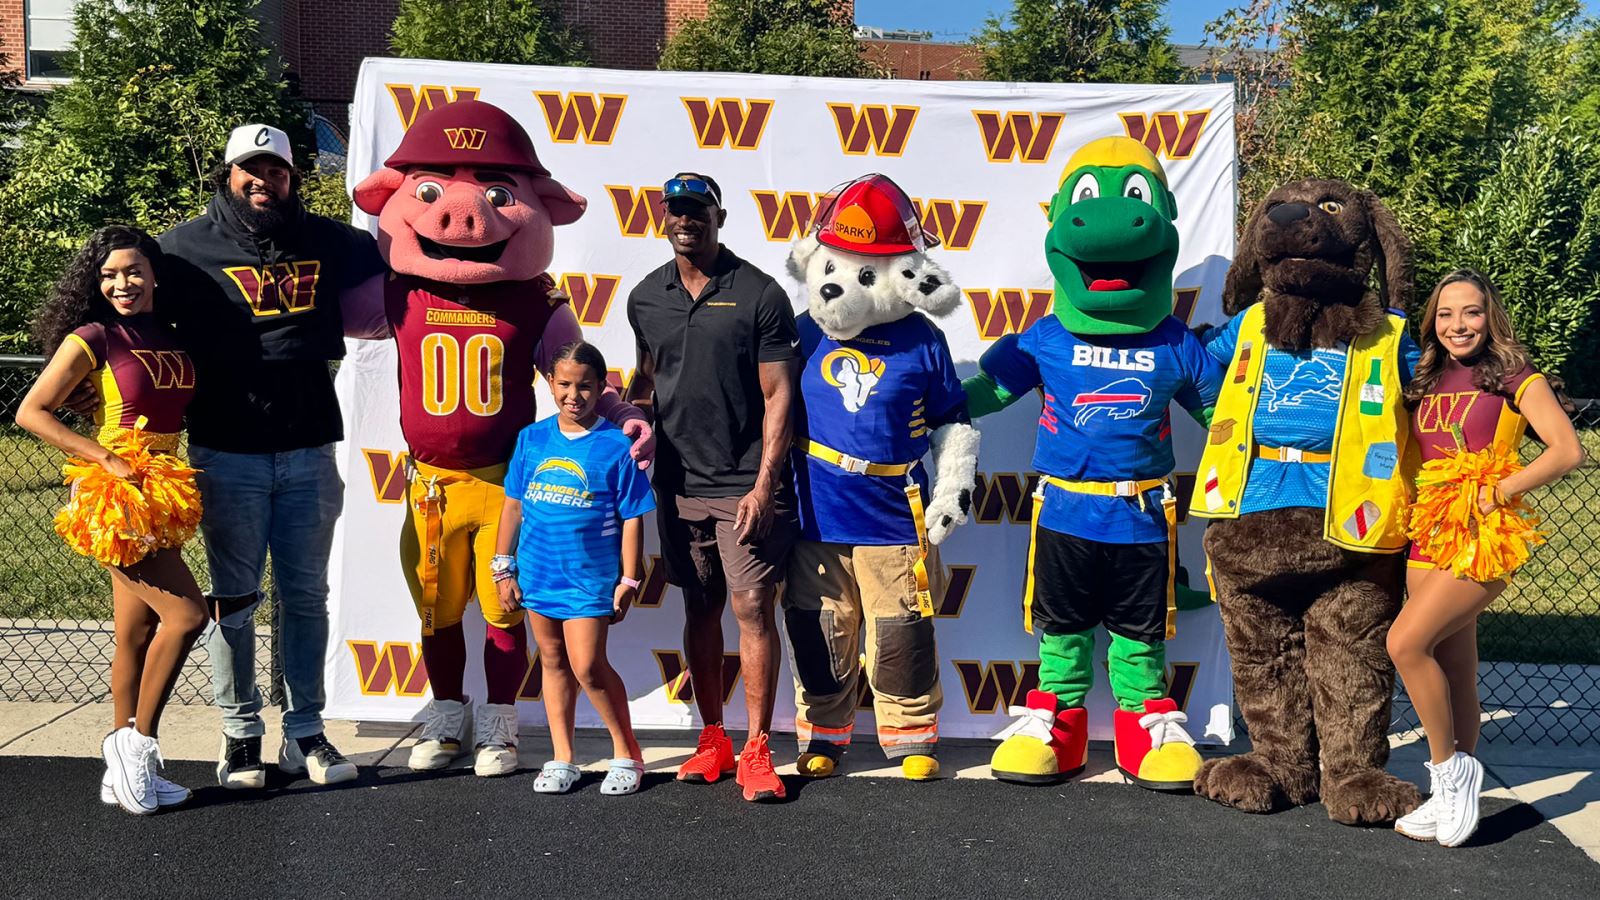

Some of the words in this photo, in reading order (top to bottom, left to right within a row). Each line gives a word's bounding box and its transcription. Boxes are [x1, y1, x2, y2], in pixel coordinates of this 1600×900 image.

[254, 127, 270, 147] C
[532, 90, 629, 145] W
[680, 96, 775, 150] W
[826, 102, 920, 157] W
[971, 110, 1066, 163] W
[1117, 108, 1212, 160] W
[443, 128, 487, 150] W
[835, 222, 874, 239] SPARKY
[222, 260, 320, 316] W
[426, 310, 496, 324] COMMANDERS
[130, 350, 195, 389] W
[421, 332, 504, 416] 00
[1072, 345, 1155, 372] BILLS
[1417, 390, 1480, 432] W
[524, 490, 593, 508] CHARGERS
